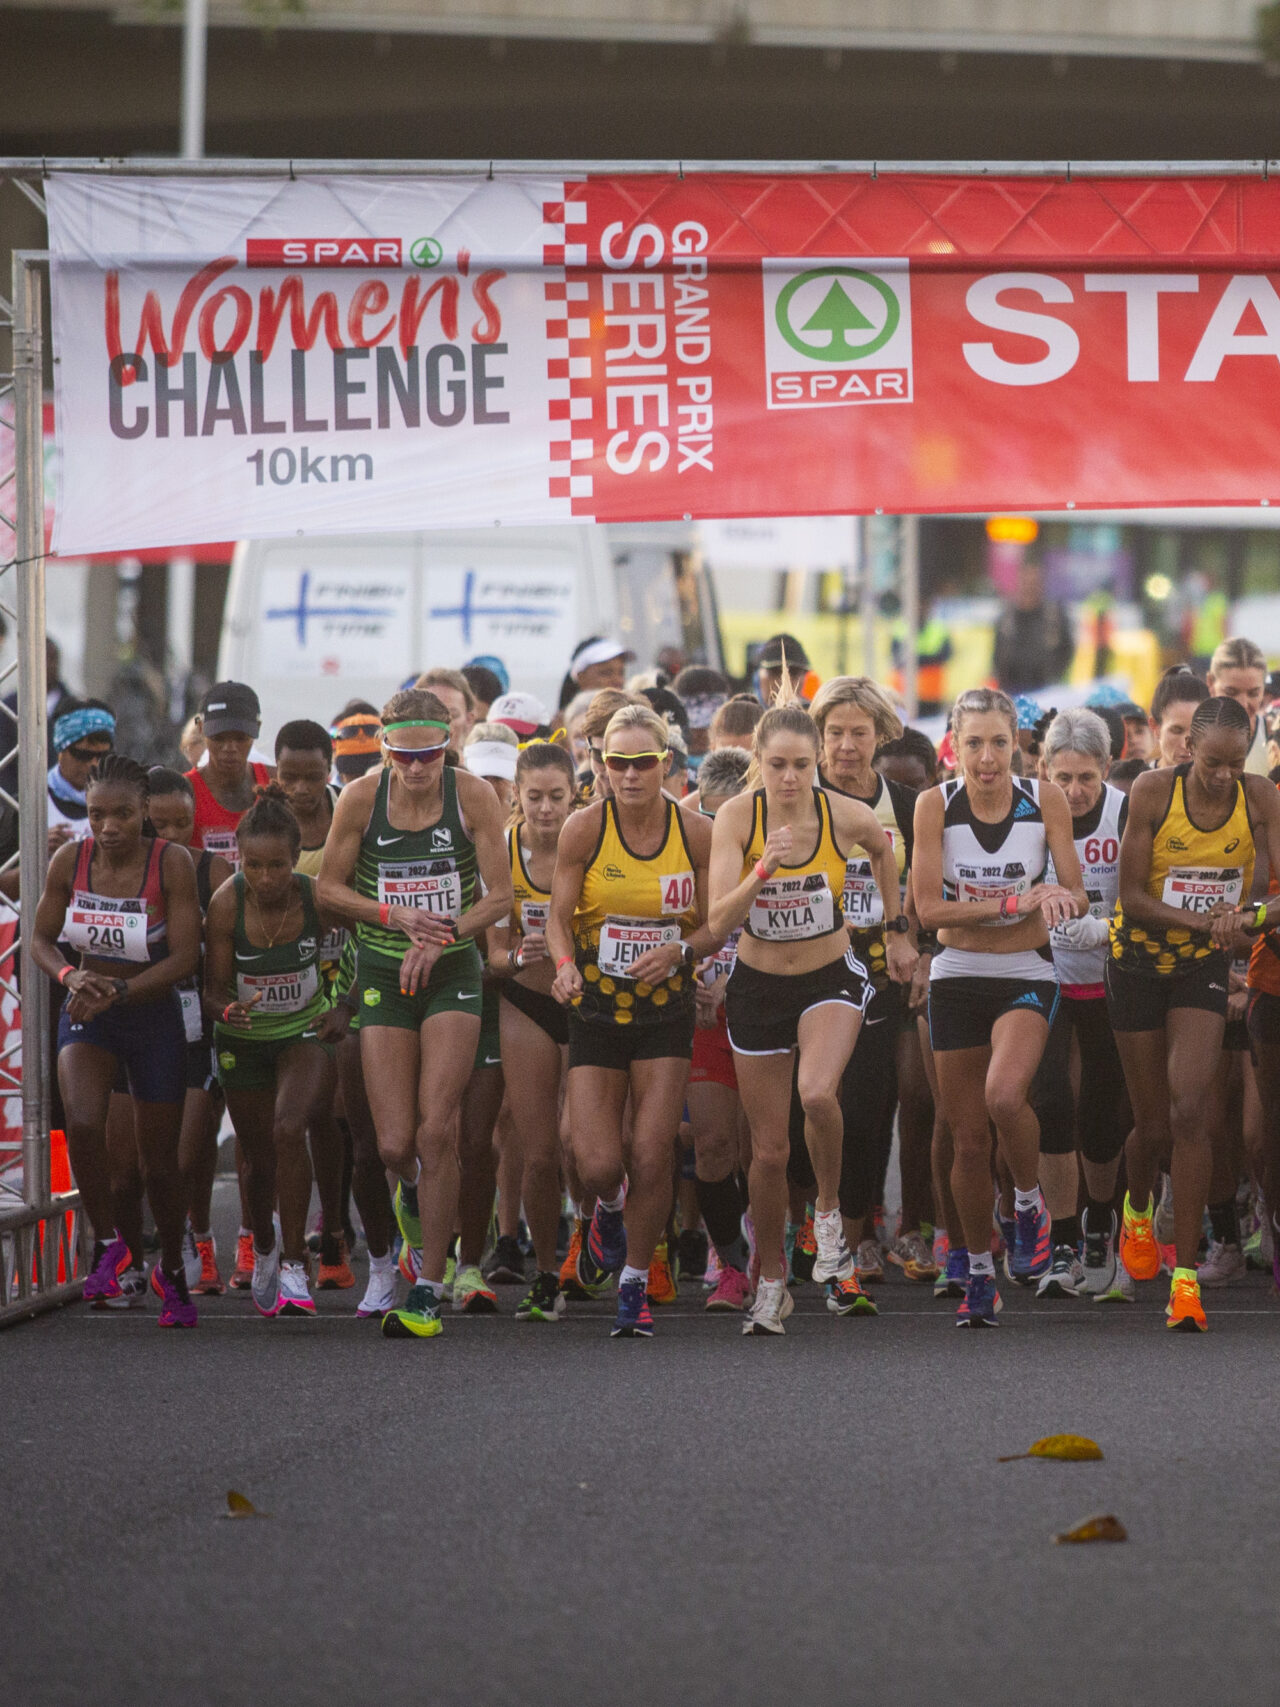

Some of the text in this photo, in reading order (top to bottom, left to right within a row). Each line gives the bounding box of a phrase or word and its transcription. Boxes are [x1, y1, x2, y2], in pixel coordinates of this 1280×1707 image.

[282, 242, 399, 265] SPAR
[105, 247, 507, 386] Women's
[600, 221, 671, 476] SERIES
[671, 220, 713, 474] GRAND PRIX
[108, 343, 511, 440] CHALLENGE
[776, 371, 904, 400] SPAR
[246, 446, 375, 486] 10km
[1013, 807, 1036, 819] adidas
[1084, 838, 1119, 864] 60
[408, 866, 427, 876] 2022
[982, 867, 1001, 877] 2022
[1005, 863, 1024, 874] ASA
[1090, 865, 1117, 875] orion
[396, 882, 437, 892] SPAR
[664, 877, 693, 909] 40
[782, 881, 801, 892] 2022
[806, 874, 823, 886] ASA
[975, 888, 1014, 898] SPAR
[1184, 884, 1225, 894] SPAR
[768, 898, 809, 909] SPAR
[84, 914, 124, 926] SPAR
[768, 907, 815, 929] KYLA
[87, 926, 125, 949] 249
[620, 930, 661, 940] SPAR
[612, 941, 668, 963] JEN
[256, 974, 297, 985] SPAR
